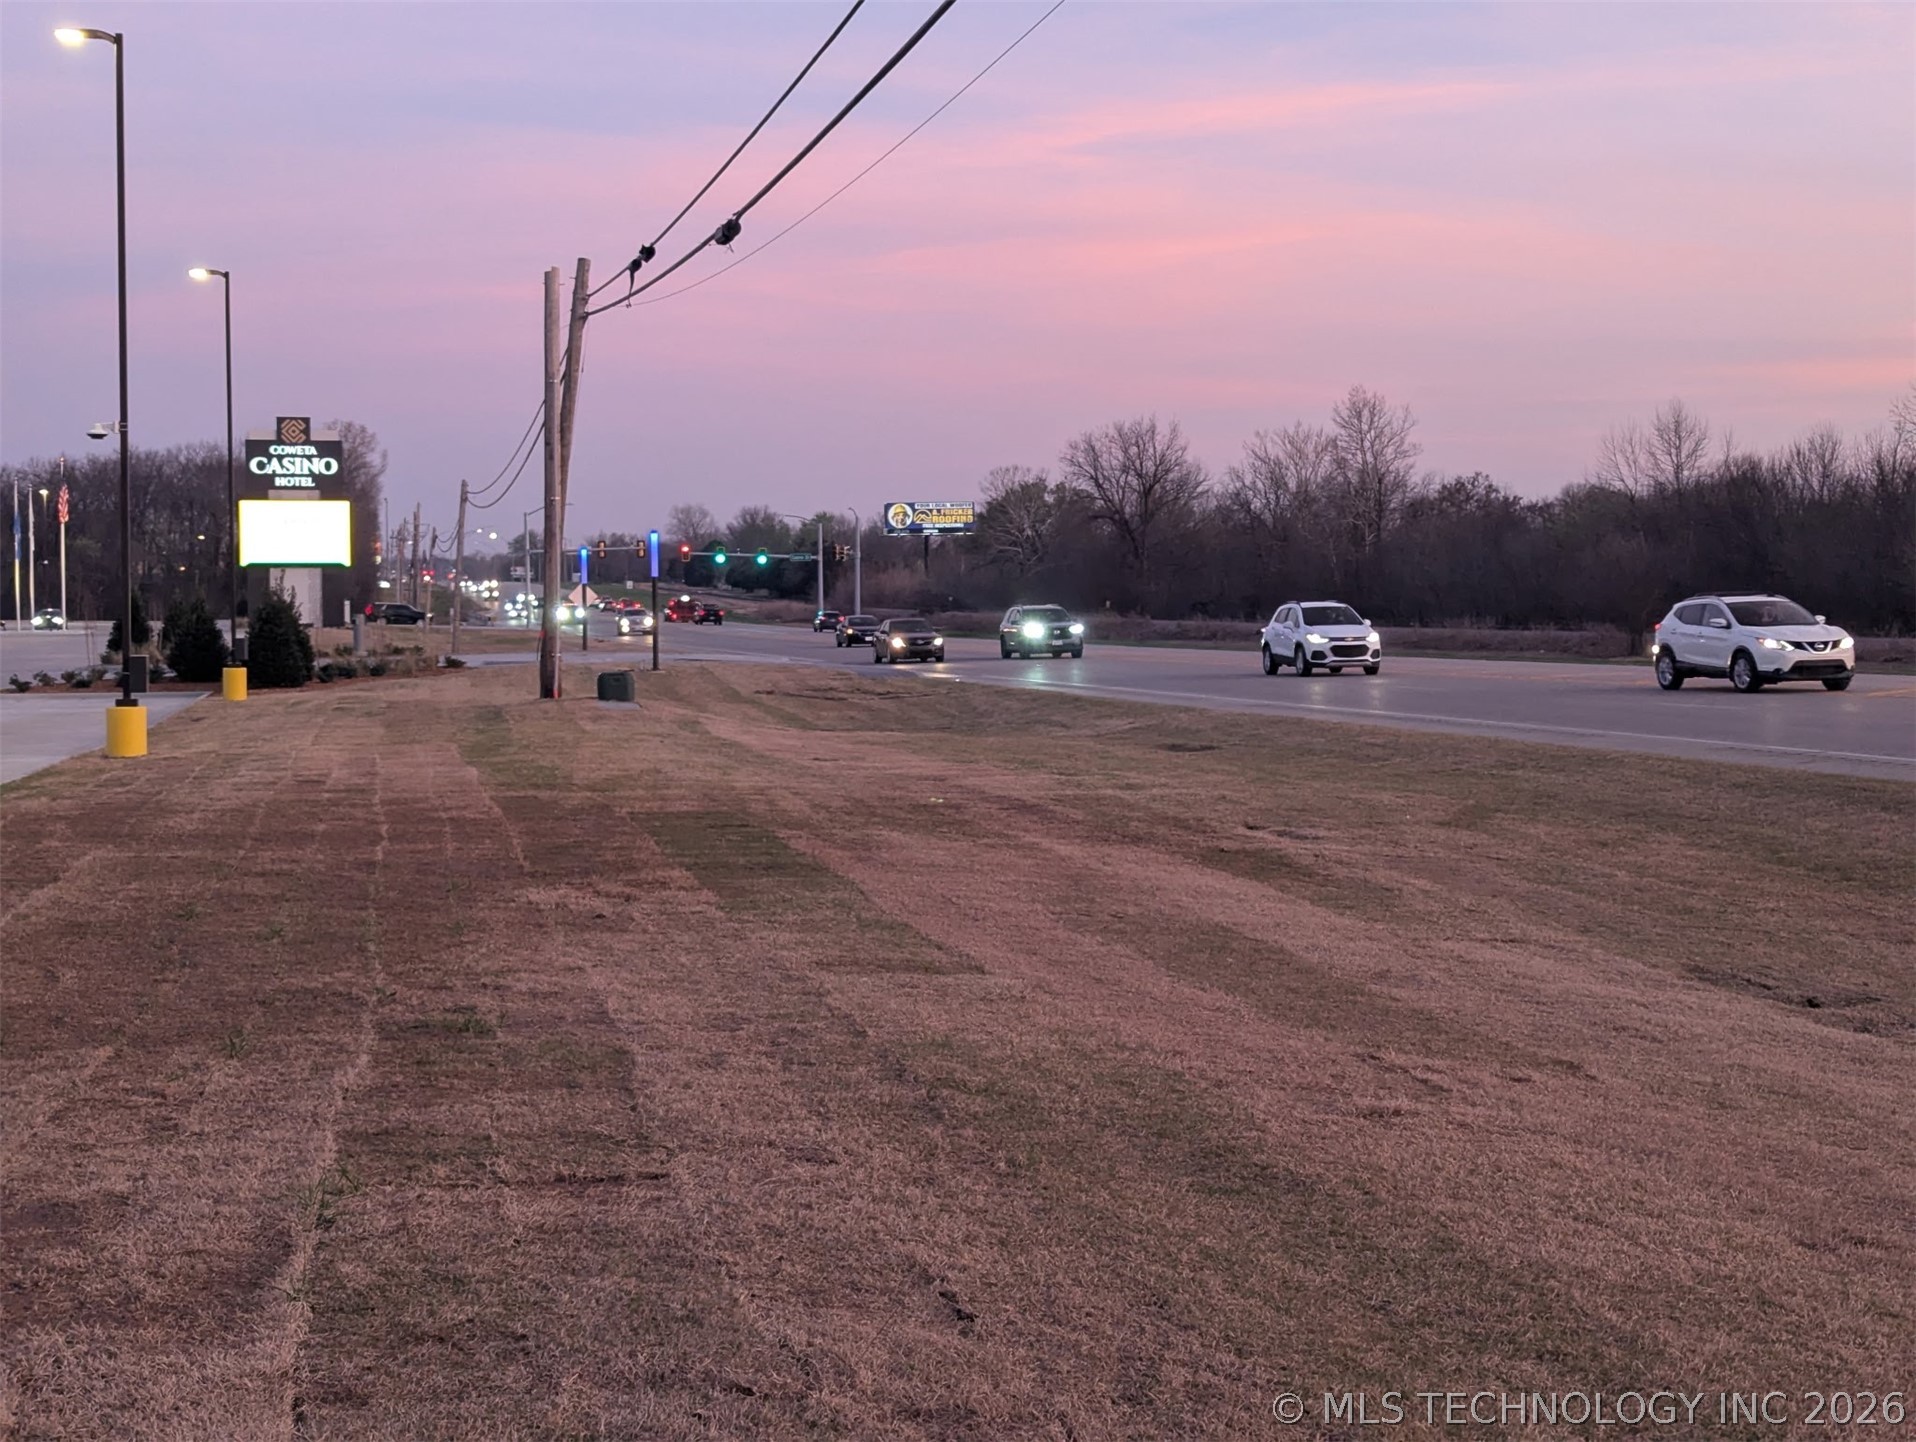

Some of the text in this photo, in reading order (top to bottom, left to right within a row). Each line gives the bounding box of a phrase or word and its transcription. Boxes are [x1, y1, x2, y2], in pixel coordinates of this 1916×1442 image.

[268, 445, 318, 455] COWETA
[249, 457, 339, 475] CASINO
[274, 477, 316, 487] HOTEL
[932, 515, 973, 523] ROOFING
